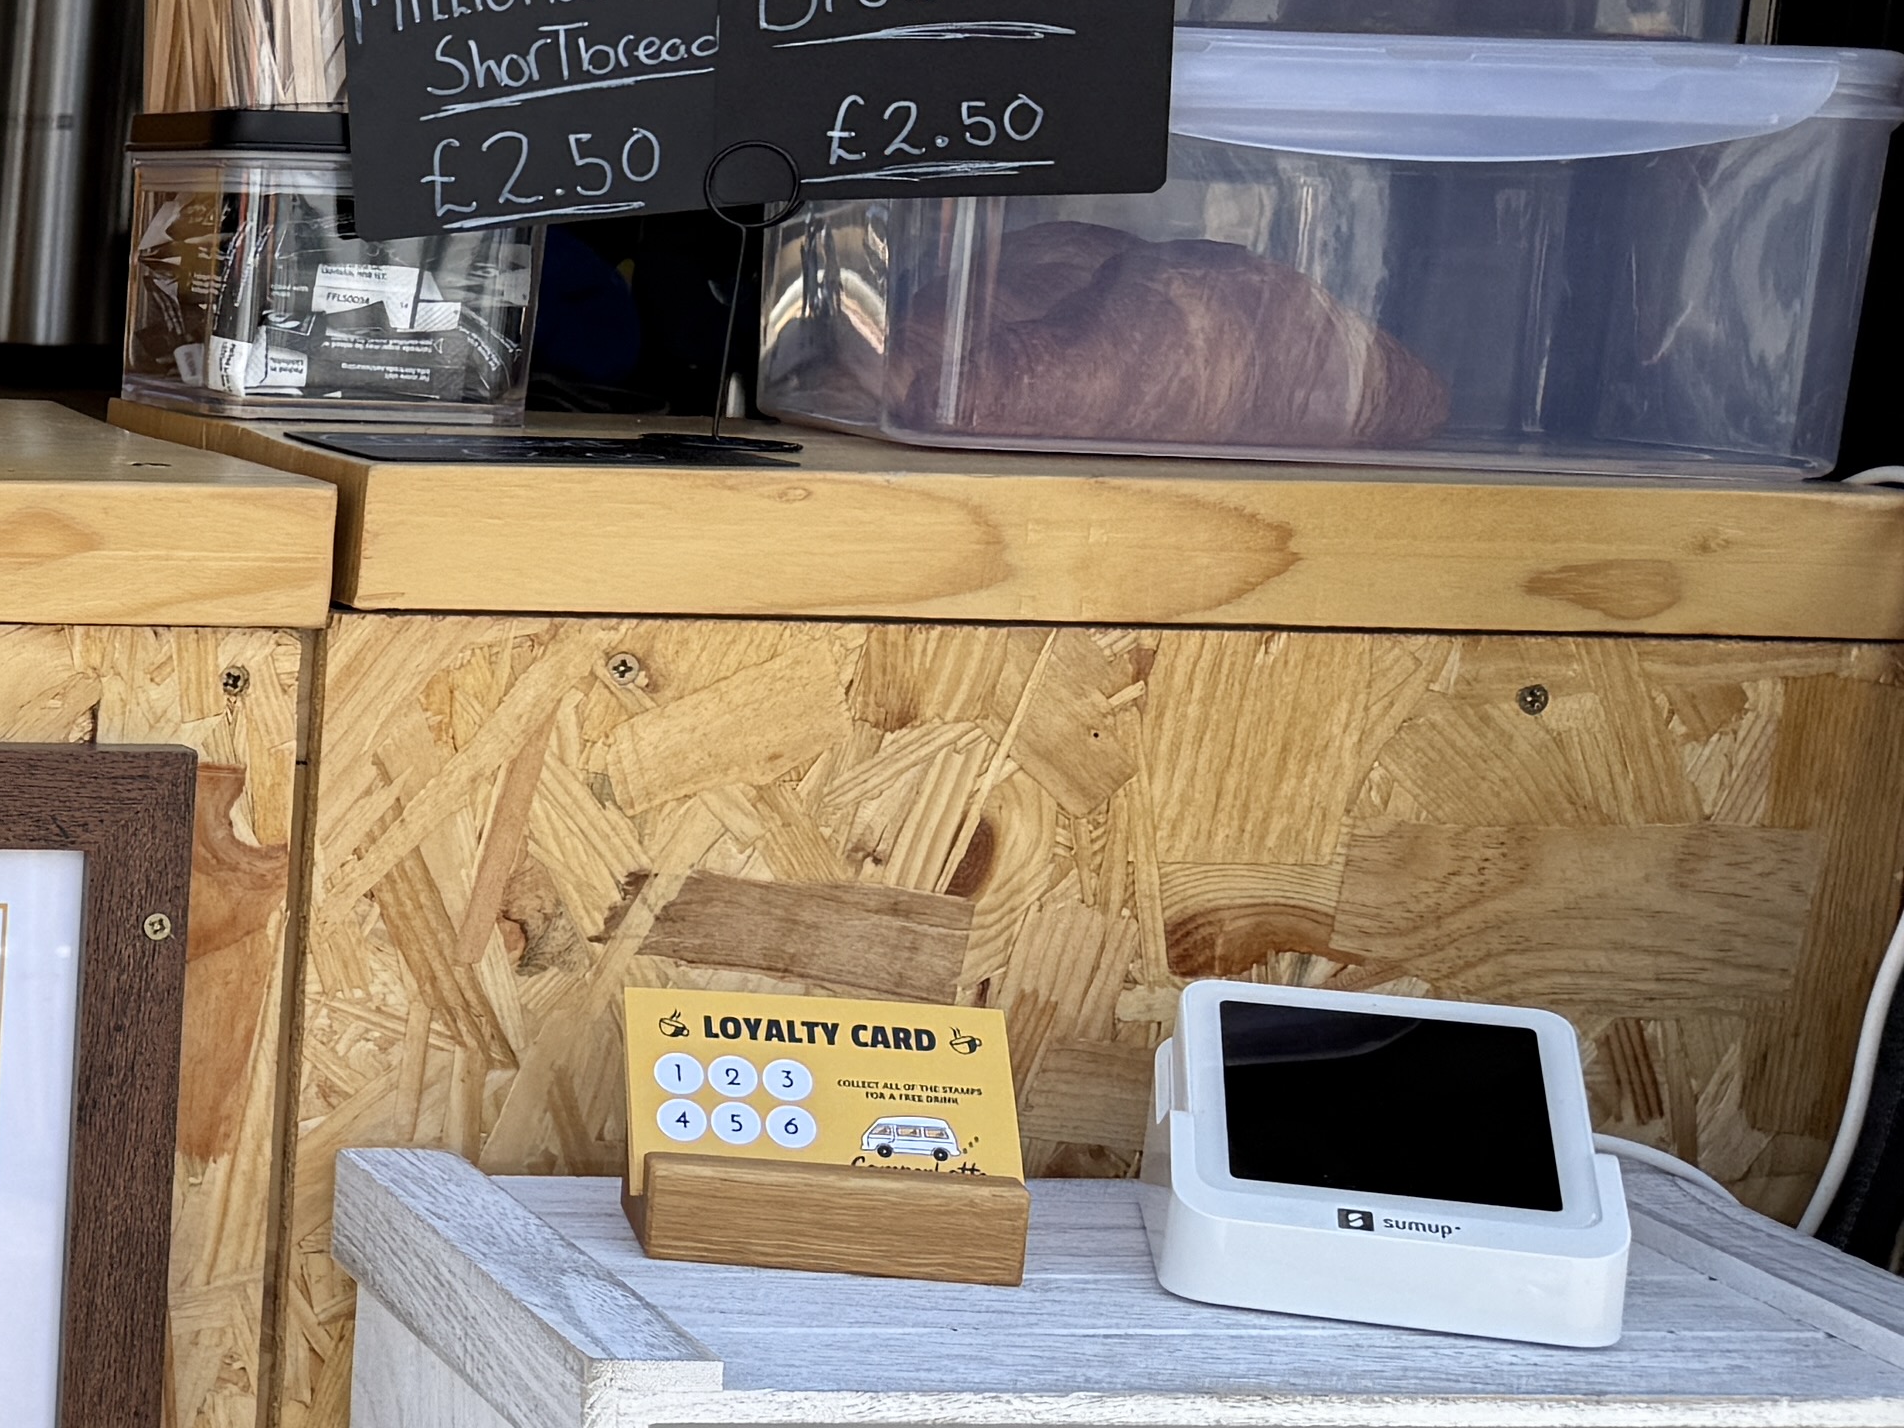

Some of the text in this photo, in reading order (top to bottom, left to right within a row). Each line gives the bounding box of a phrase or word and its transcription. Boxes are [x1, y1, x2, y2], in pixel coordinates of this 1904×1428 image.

[826, 93, 1046, 162] £2.50
[418, 126, 664, 220] £2.50
[704, 1014, 937, 1052] LOYALTY CARD
[674, 1064, 795, 1089] 1 2 3
[837, 1078, 879, 1089] COLLECT
[882, 1081, 900, 1091] ALL
[941, 1085, 983, 1096] STAMPS
[674, 1110, 799, 1136] 4 5 6
[1382, 1215, 1454, 1239] sumup
